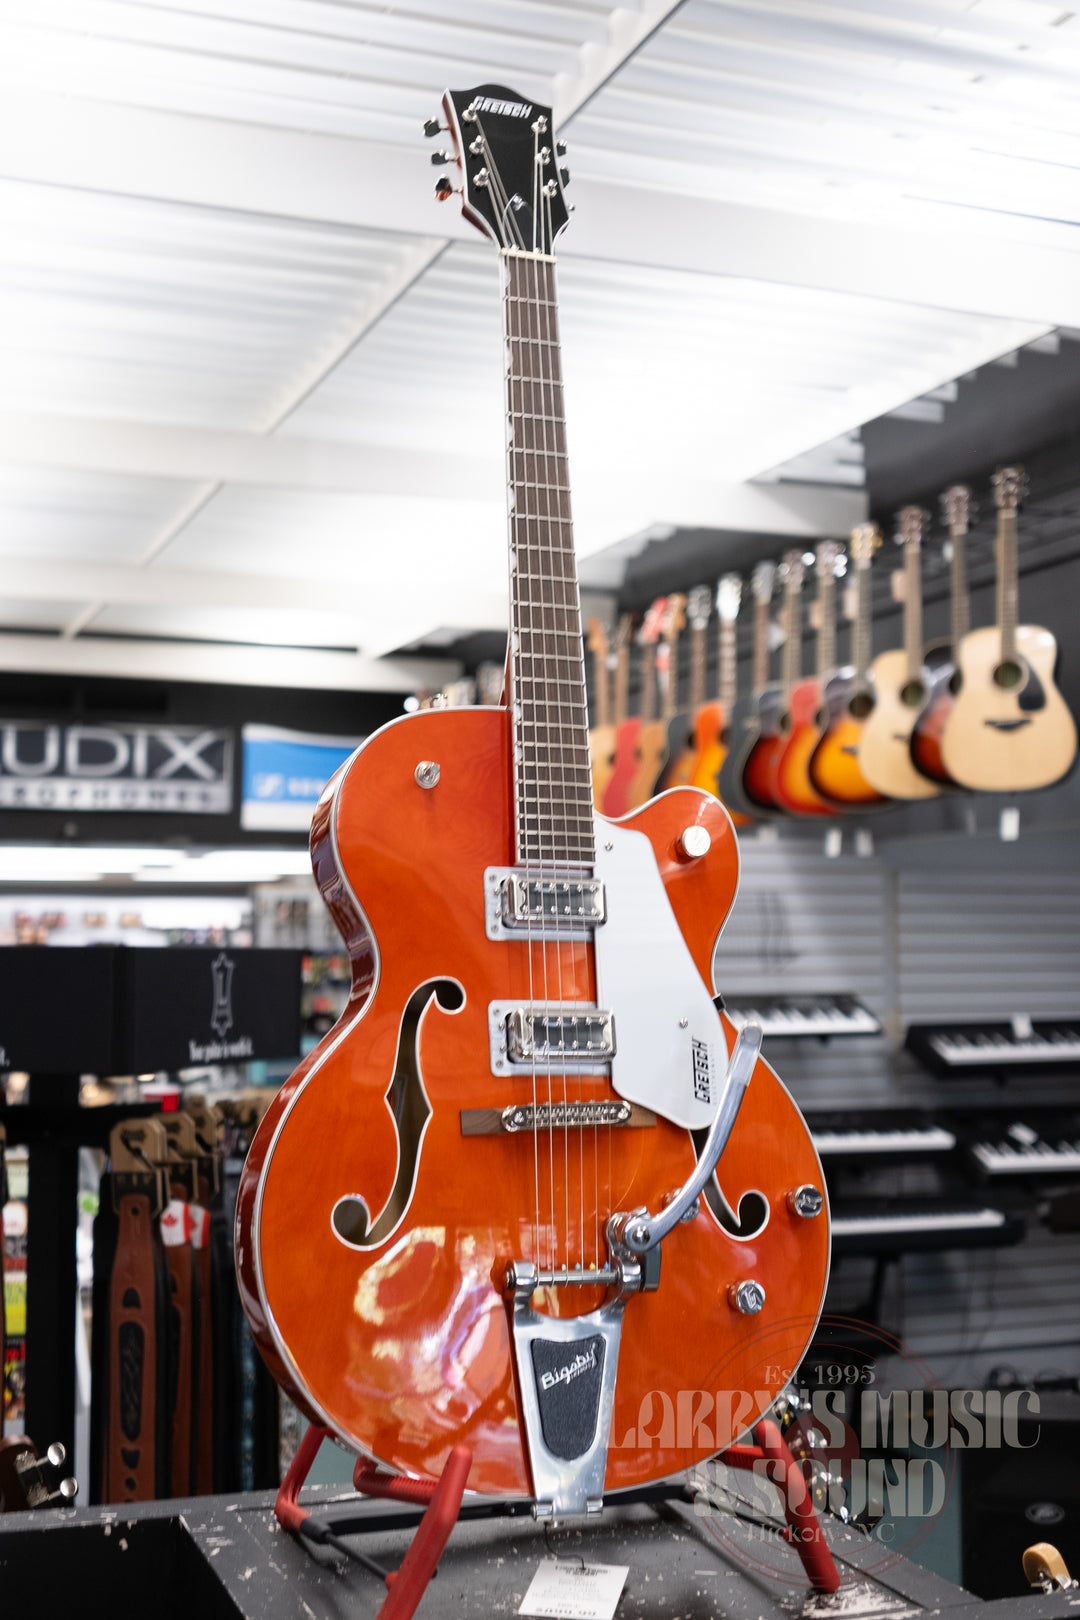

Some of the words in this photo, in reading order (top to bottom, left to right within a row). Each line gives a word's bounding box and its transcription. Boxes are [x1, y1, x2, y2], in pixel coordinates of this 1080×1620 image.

[0, 726, 218, 780] UDIX
[692, 1033, 711, 1104] GRETSCH
[541, 1342, 597, 1391] Bigsby
